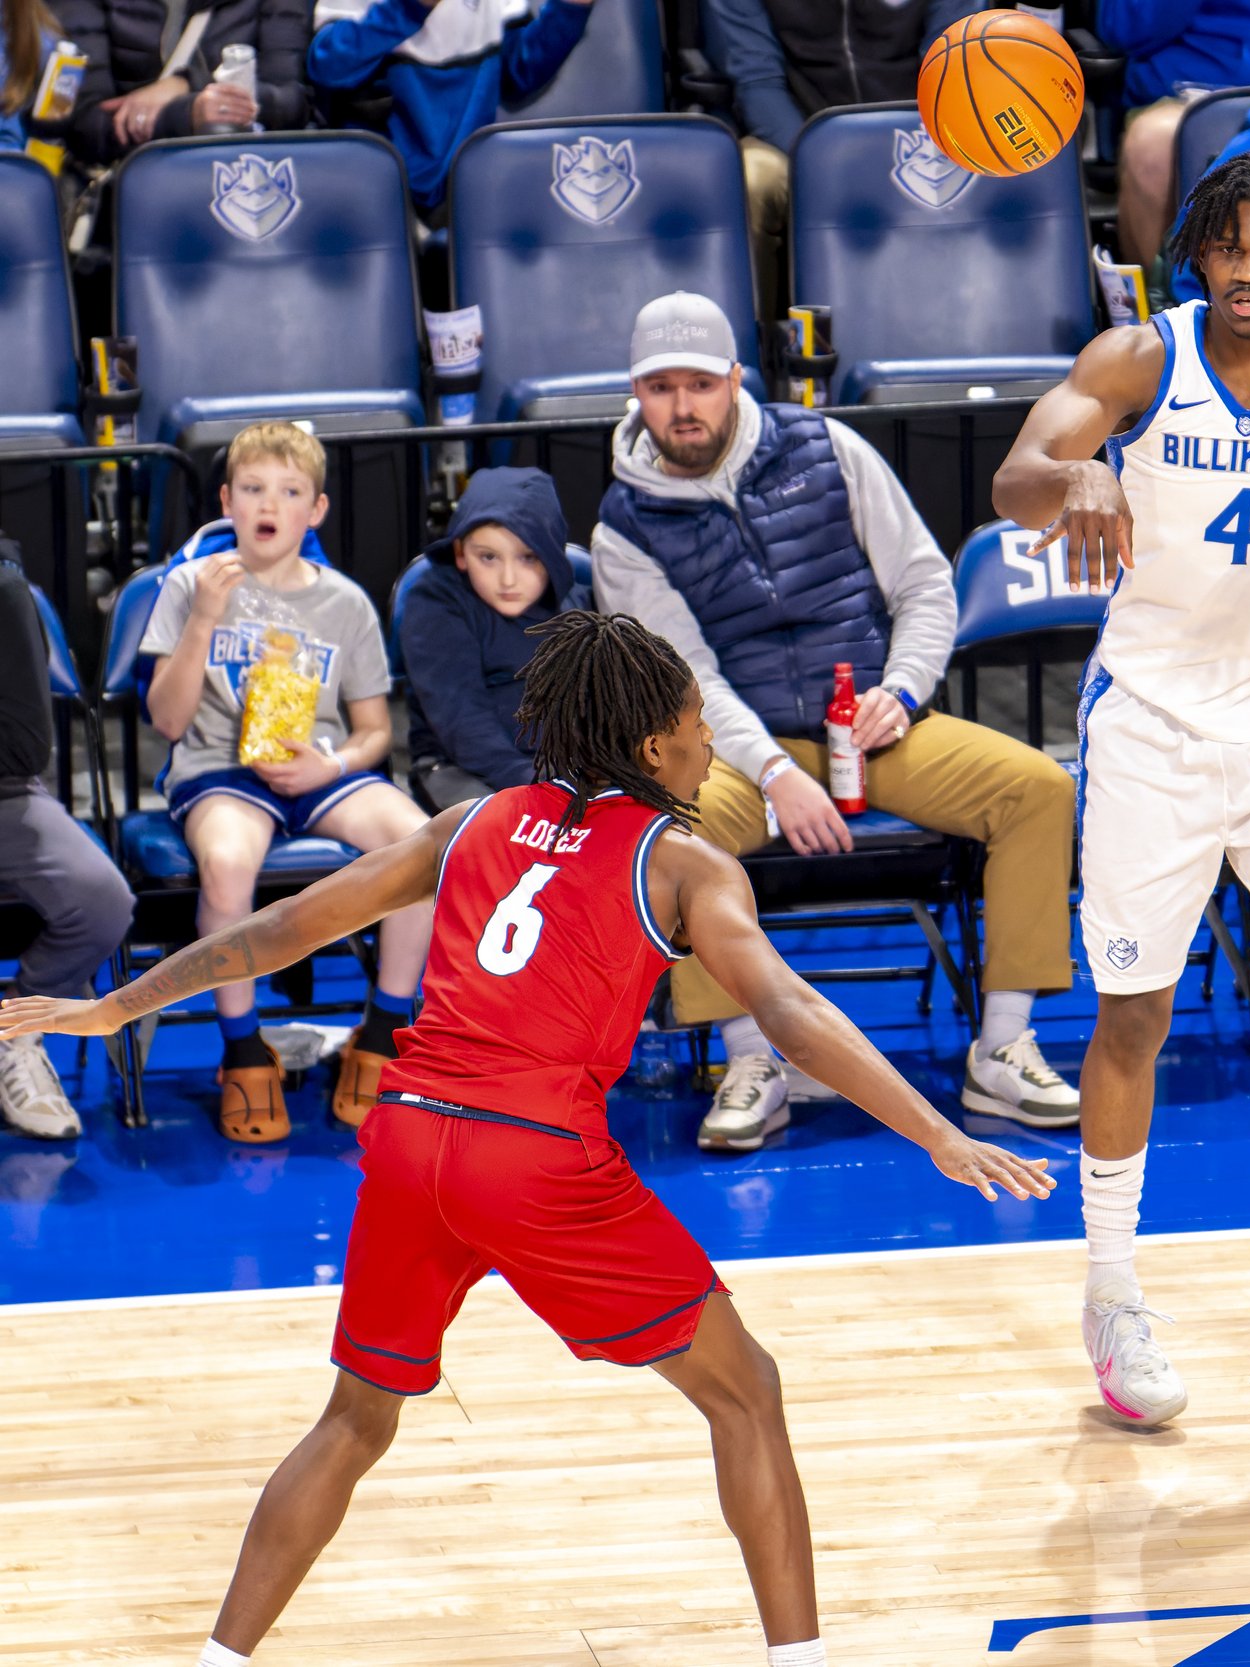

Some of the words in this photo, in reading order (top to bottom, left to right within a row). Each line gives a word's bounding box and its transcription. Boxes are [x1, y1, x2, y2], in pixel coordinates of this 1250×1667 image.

[993, 106, 1047, 168] ELITE
[1000, 529, 1113, 606] SL
[477, 862, 561, 977] 6
